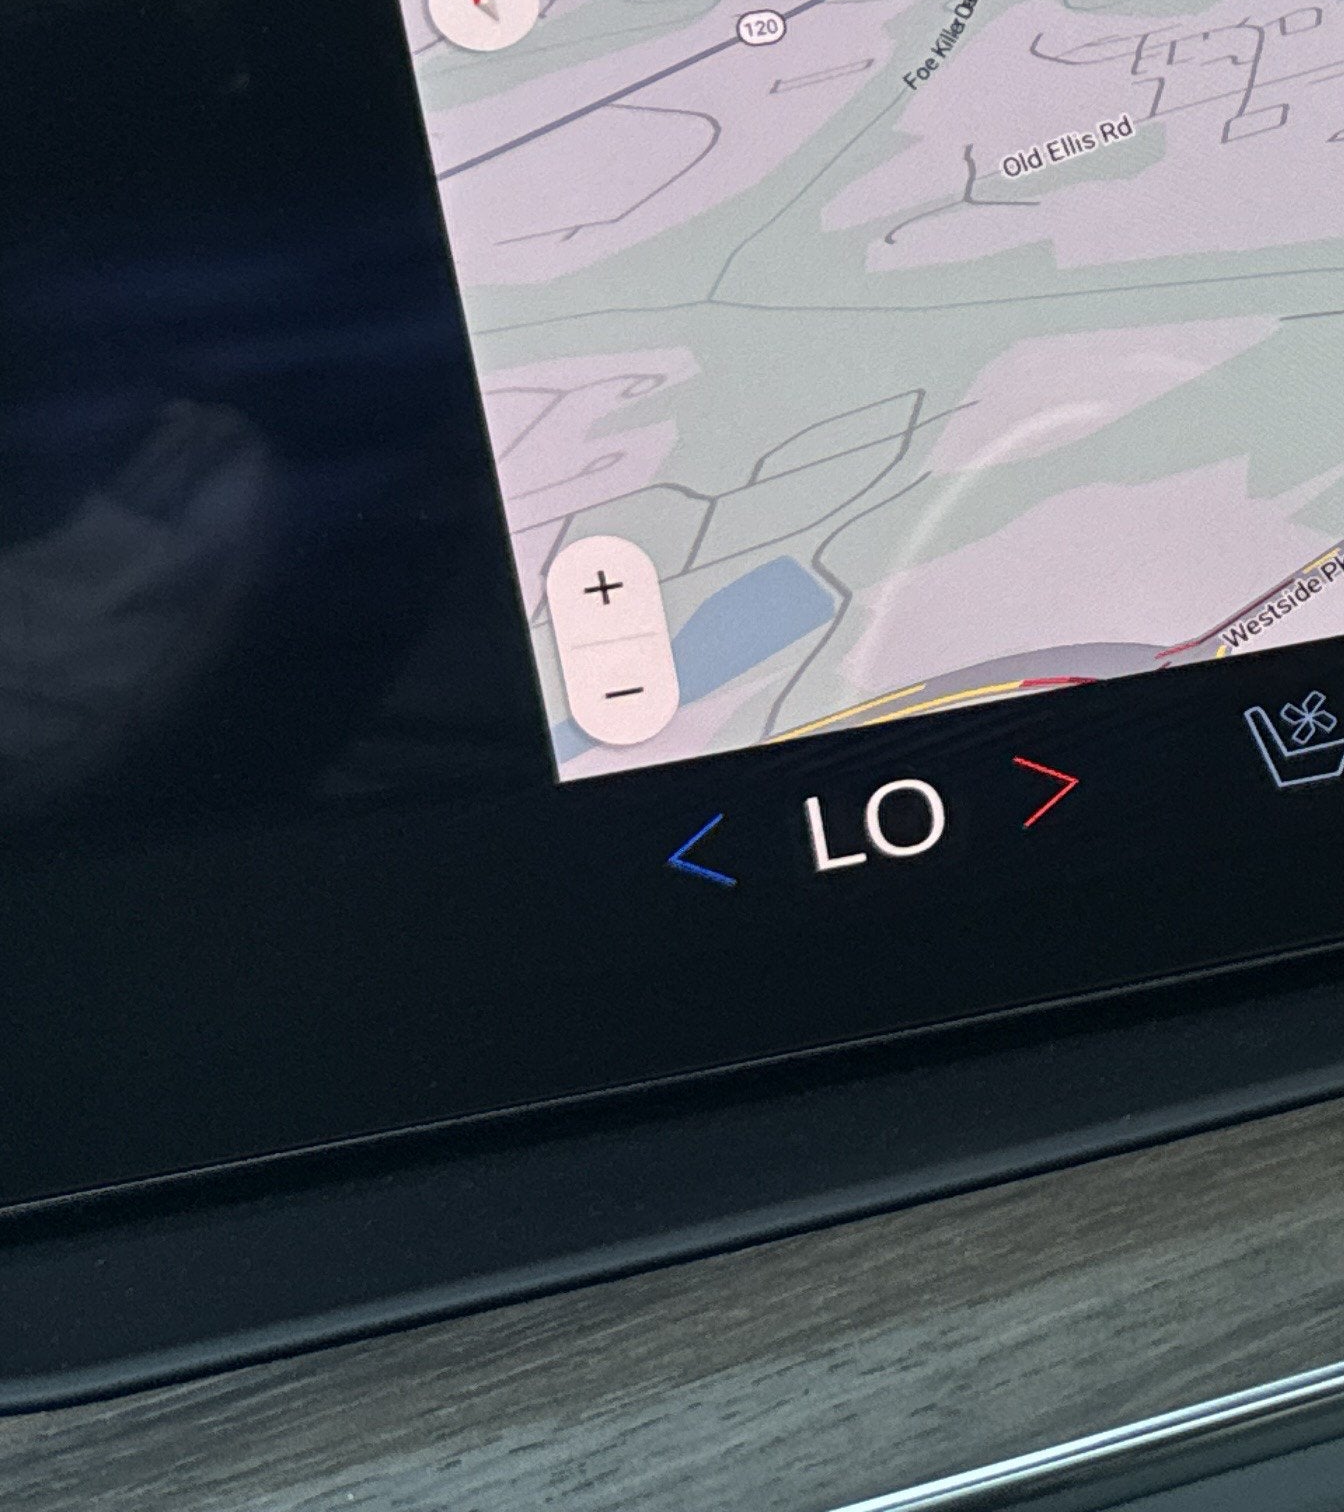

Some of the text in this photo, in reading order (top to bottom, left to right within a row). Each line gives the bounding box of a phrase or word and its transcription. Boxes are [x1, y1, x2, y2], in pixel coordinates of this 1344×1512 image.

[743, 16, 779, 38] 120
[902, 58, 940, 90] Foe
[1001, 115, 1134, 180] Old Ellis Rd
[1221, 570, 1326, 653] Westside
[802, 777, 947, 873] LO
